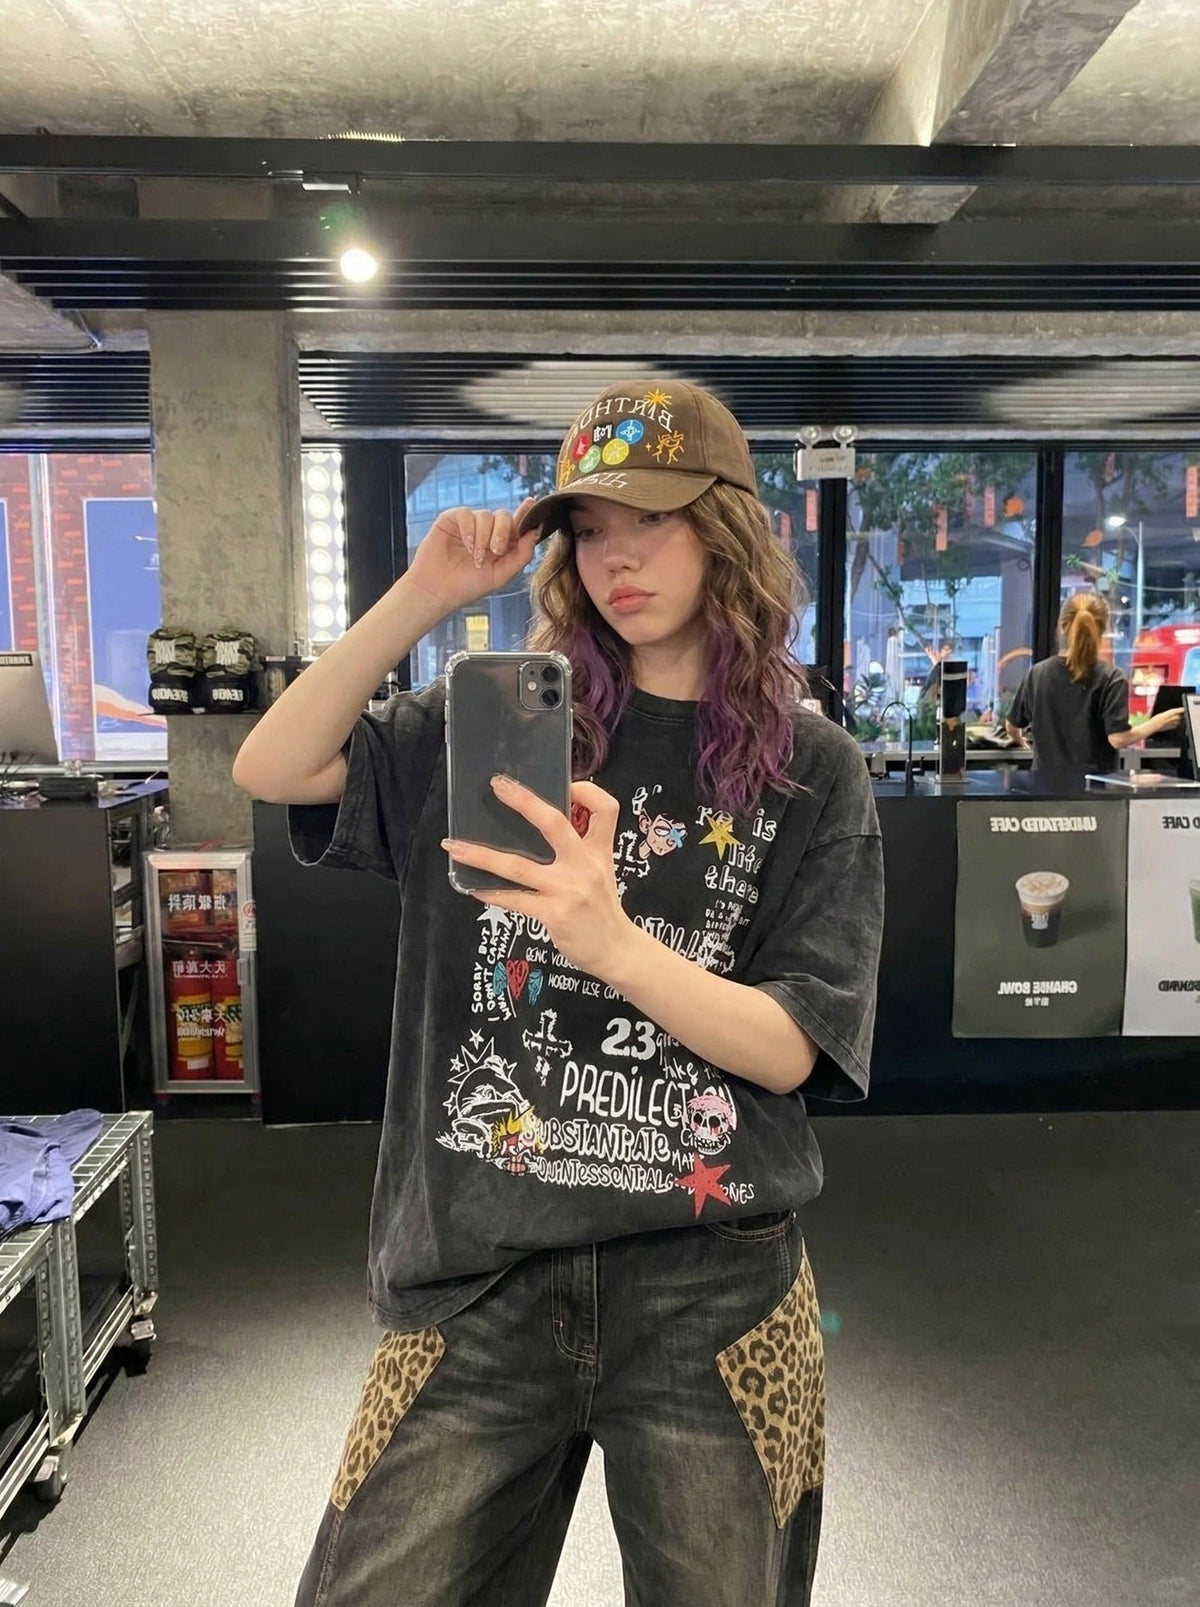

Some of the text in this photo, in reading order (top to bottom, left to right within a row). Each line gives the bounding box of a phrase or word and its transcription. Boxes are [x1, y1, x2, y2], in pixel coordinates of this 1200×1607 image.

[752, 807, 777, 842] is
[478, 927, 490, 955] BUT
[601, 1017, 656, 1061] 23
